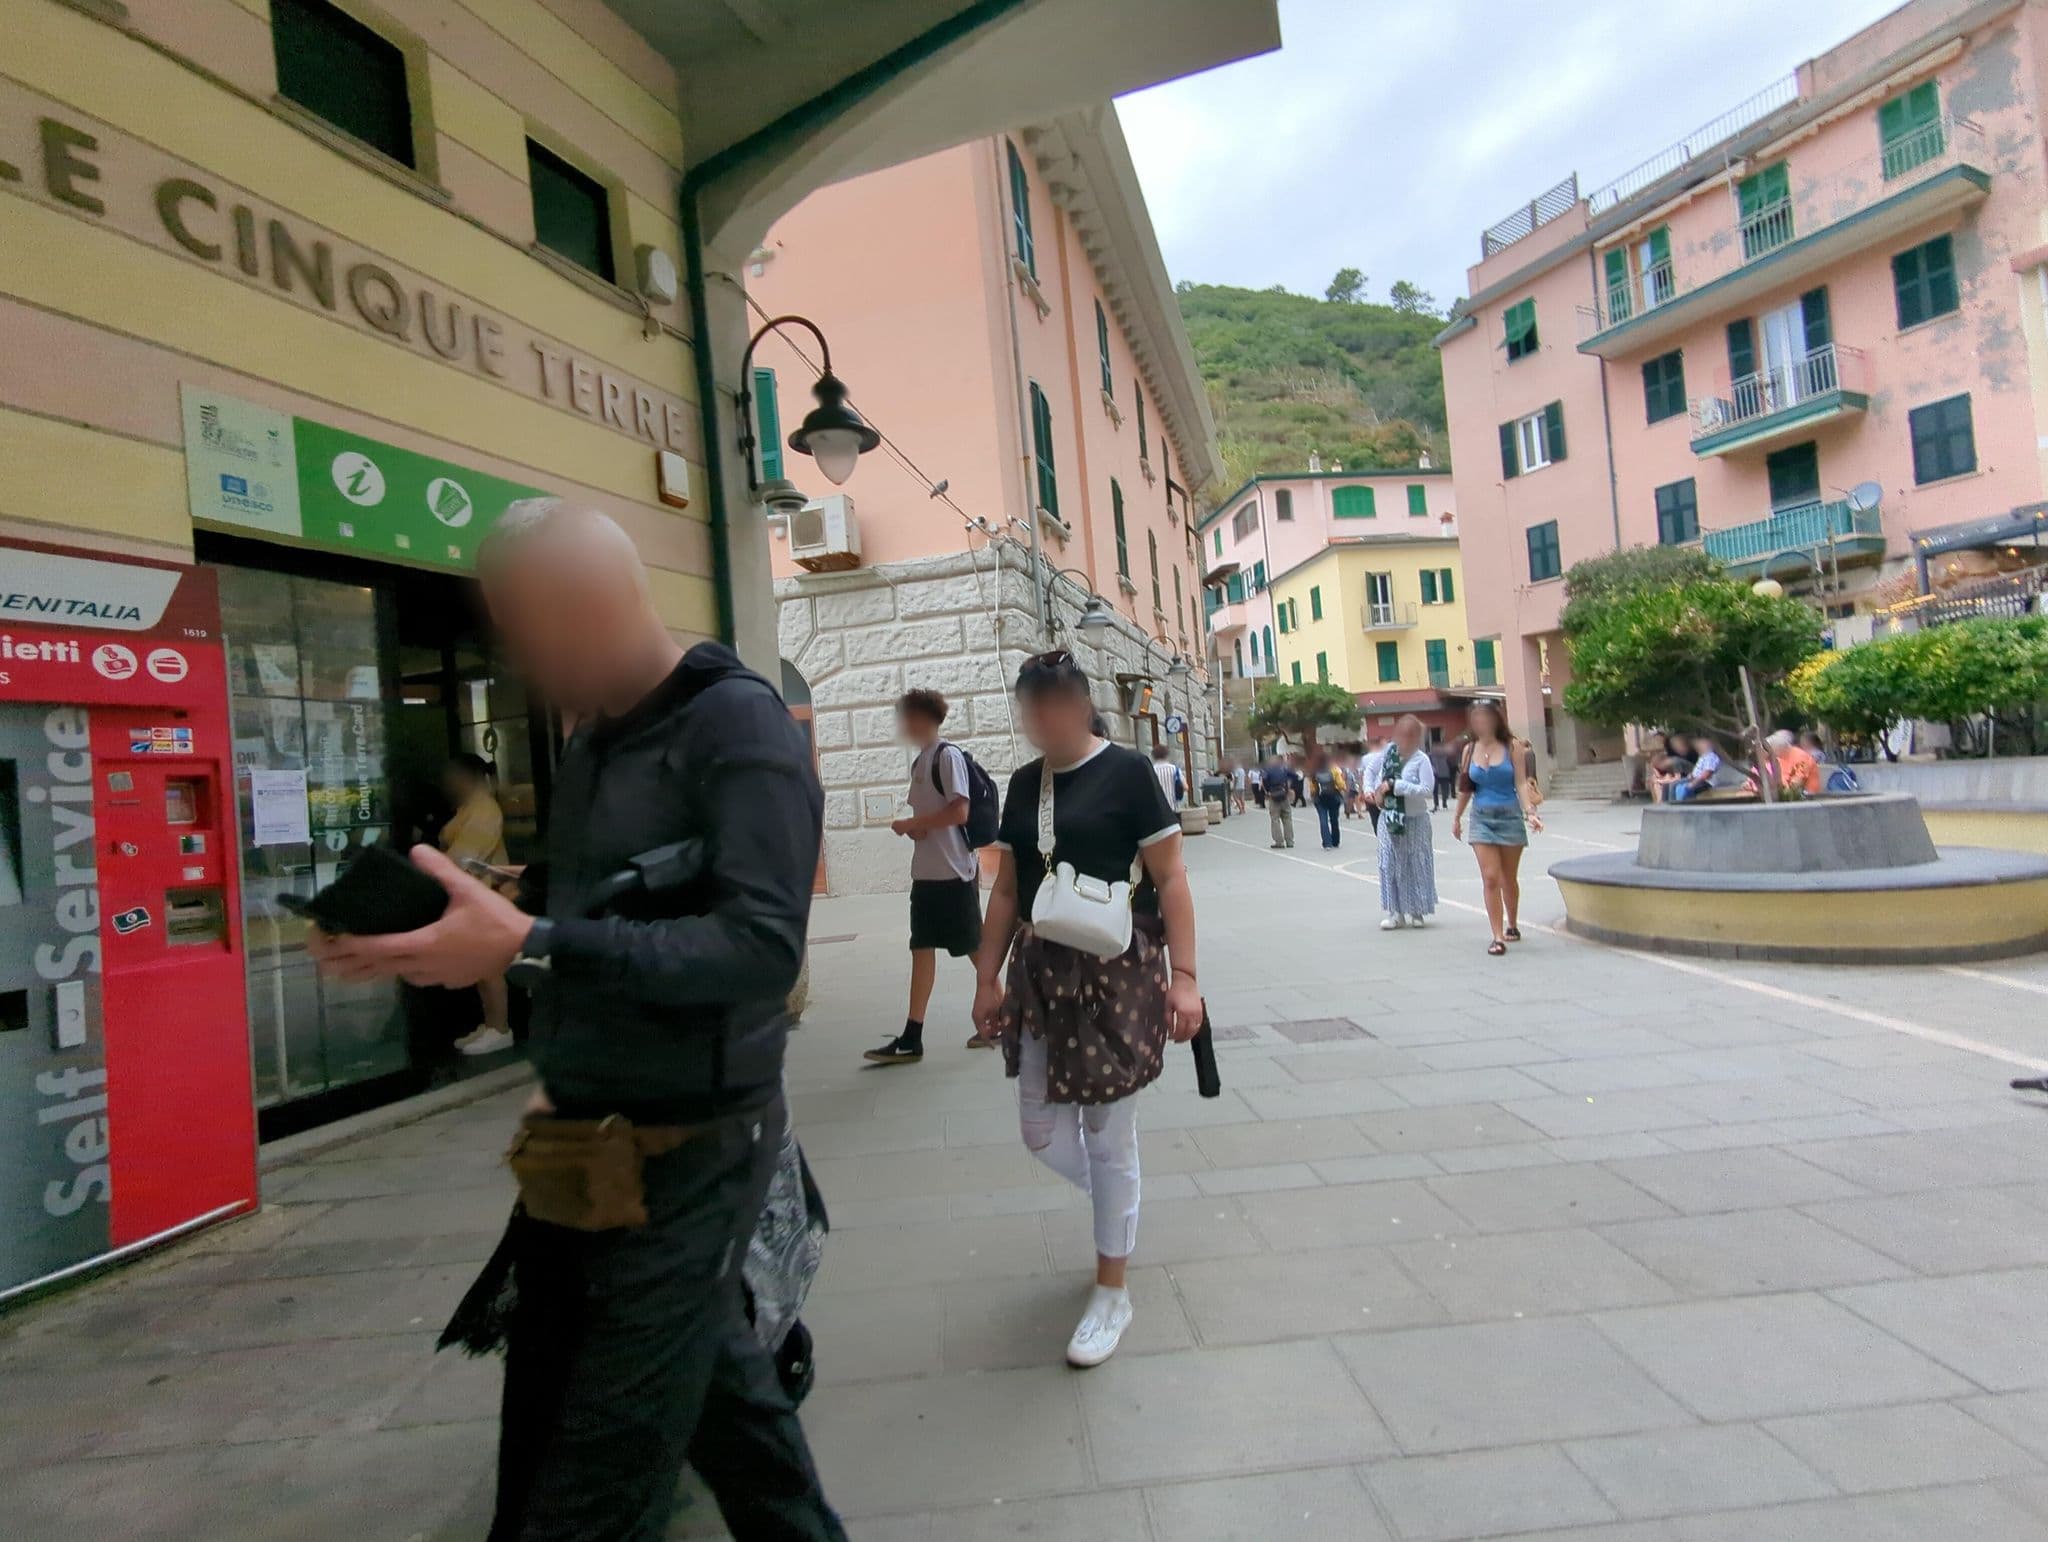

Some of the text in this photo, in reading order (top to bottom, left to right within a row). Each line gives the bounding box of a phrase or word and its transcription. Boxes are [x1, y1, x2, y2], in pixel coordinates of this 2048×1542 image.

[0, 117, 684, 453] E CINQUE TERRE
[222, 494, 274, 512] unesco
[0, 593, 141, 621] ENITALIA
[352, 704, 371, 820] Cinque Terre Card
[26, 707, 111, 1217] Self Service
